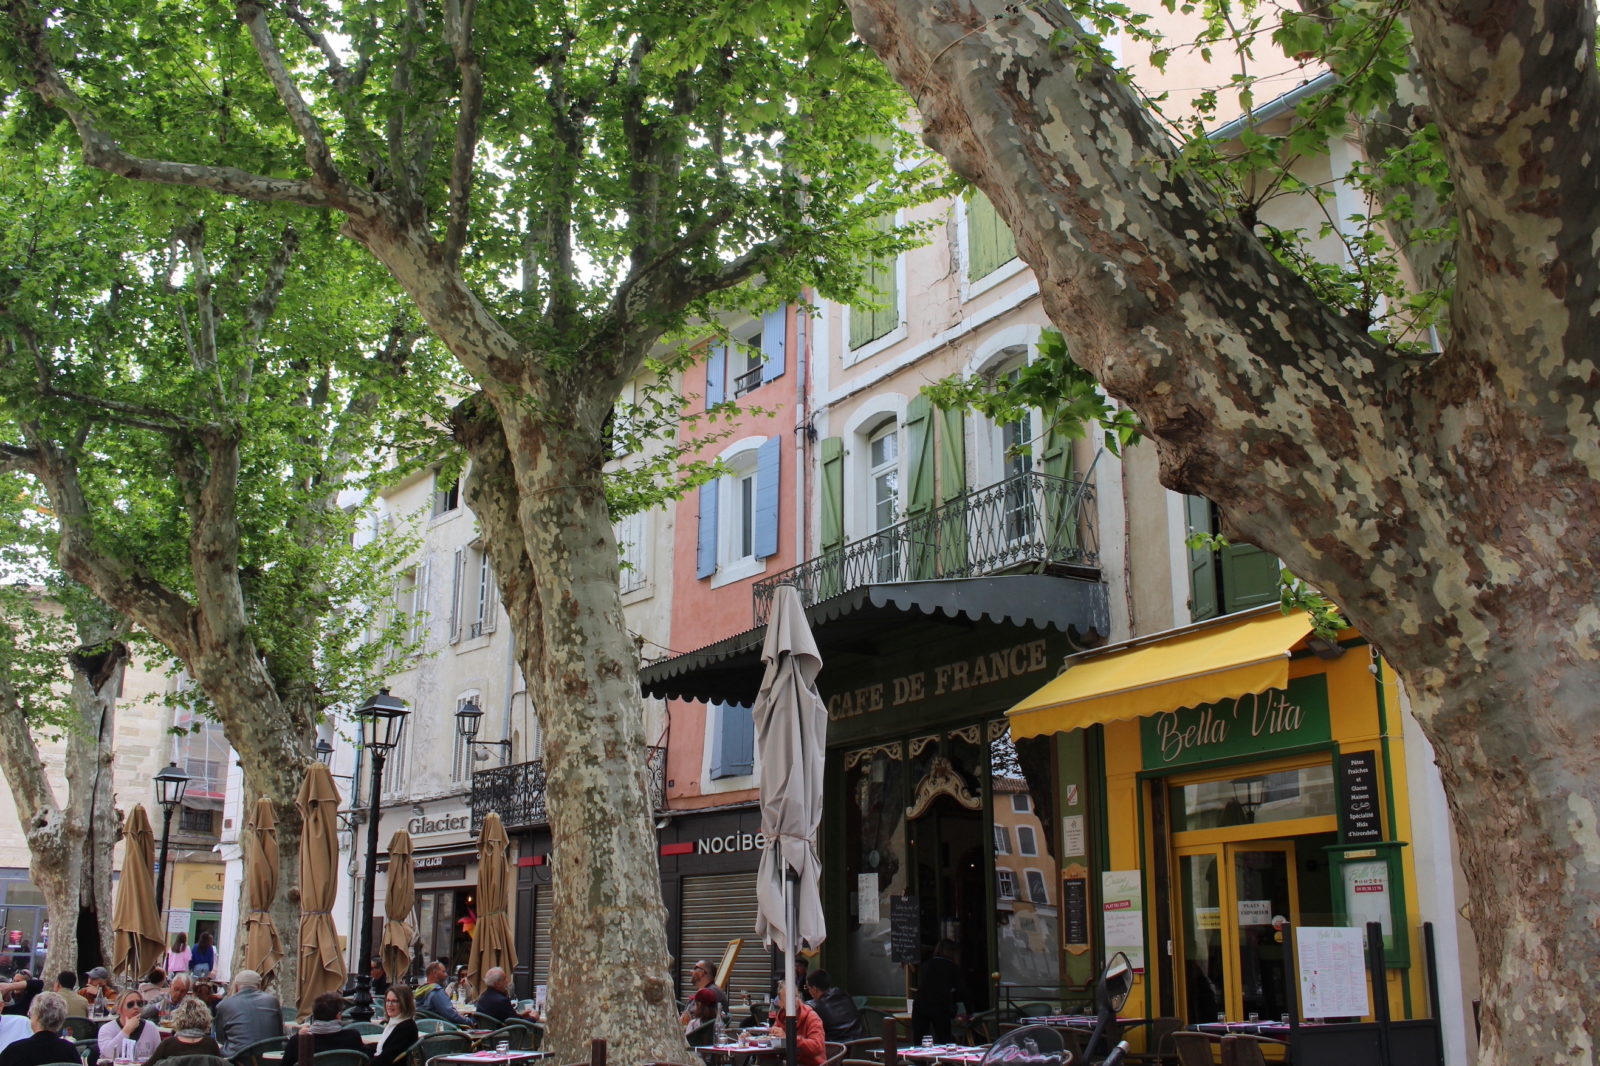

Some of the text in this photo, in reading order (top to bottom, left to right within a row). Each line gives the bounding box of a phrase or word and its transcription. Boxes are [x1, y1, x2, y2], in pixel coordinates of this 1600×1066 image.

[828, 639, 1047, 721] CAFE DE FRANCE
[1157, 690, 1305, 762] Bella Vita
[408, 813, 469, 835] Glacier
